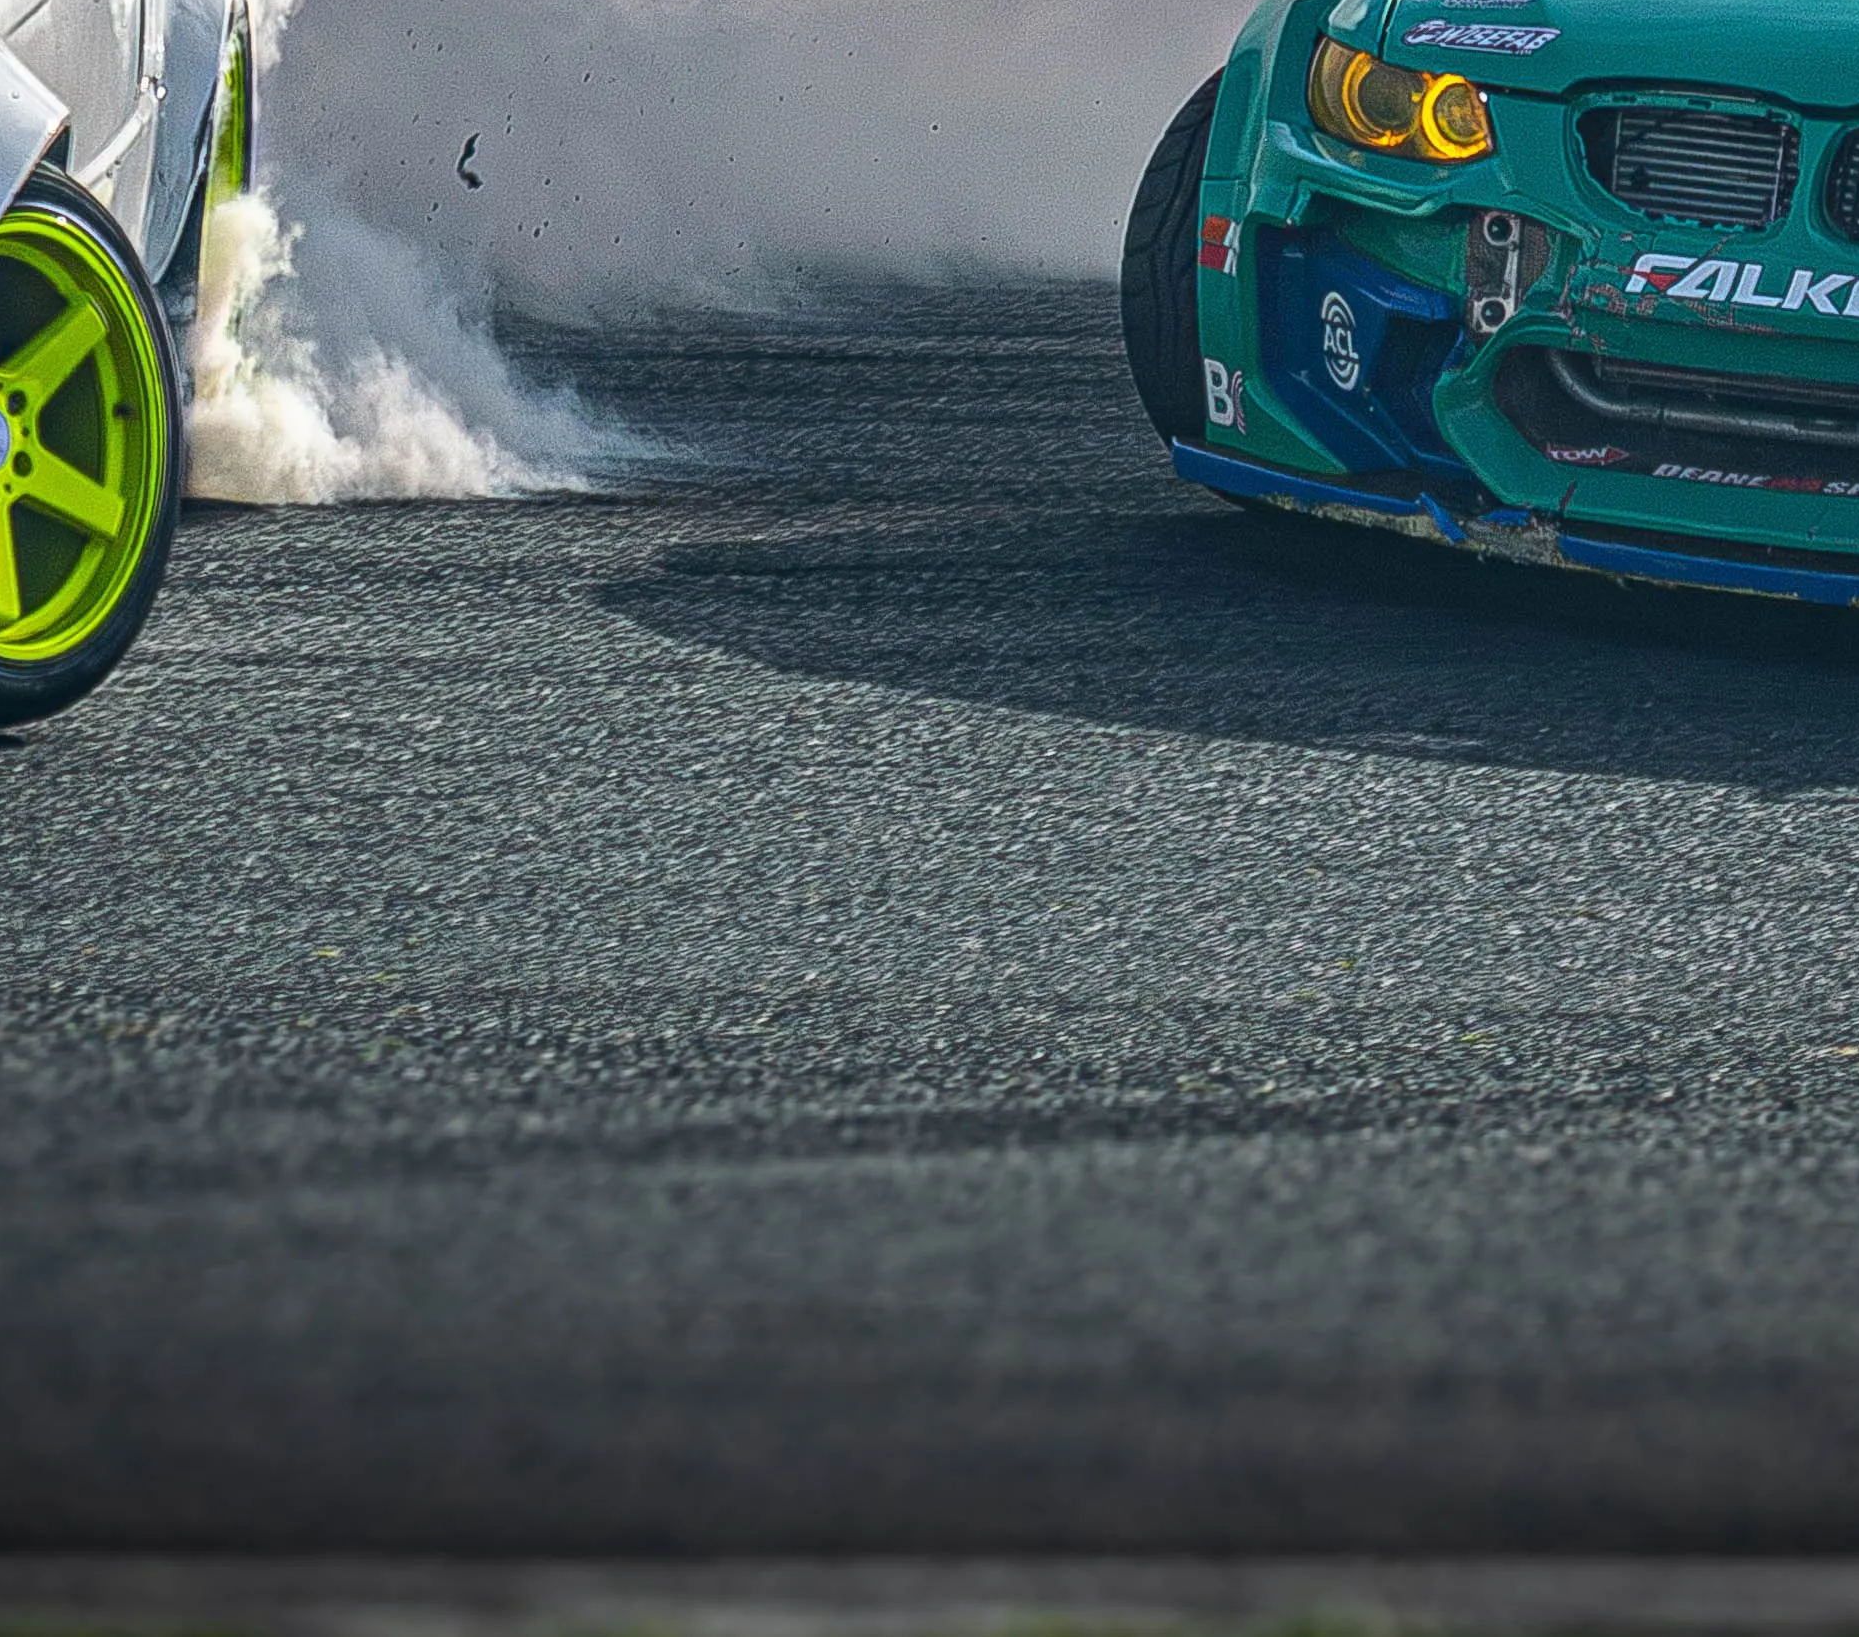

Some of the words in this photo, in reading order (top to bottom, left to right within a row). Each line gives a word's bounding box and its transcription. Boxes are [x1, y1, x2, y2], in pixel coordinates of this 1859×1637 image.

[1323, 323, 1360, 359] ACL
[1550, 447, 1609, 461] TOW
[1652, 462, 1773, 489] DEANE
